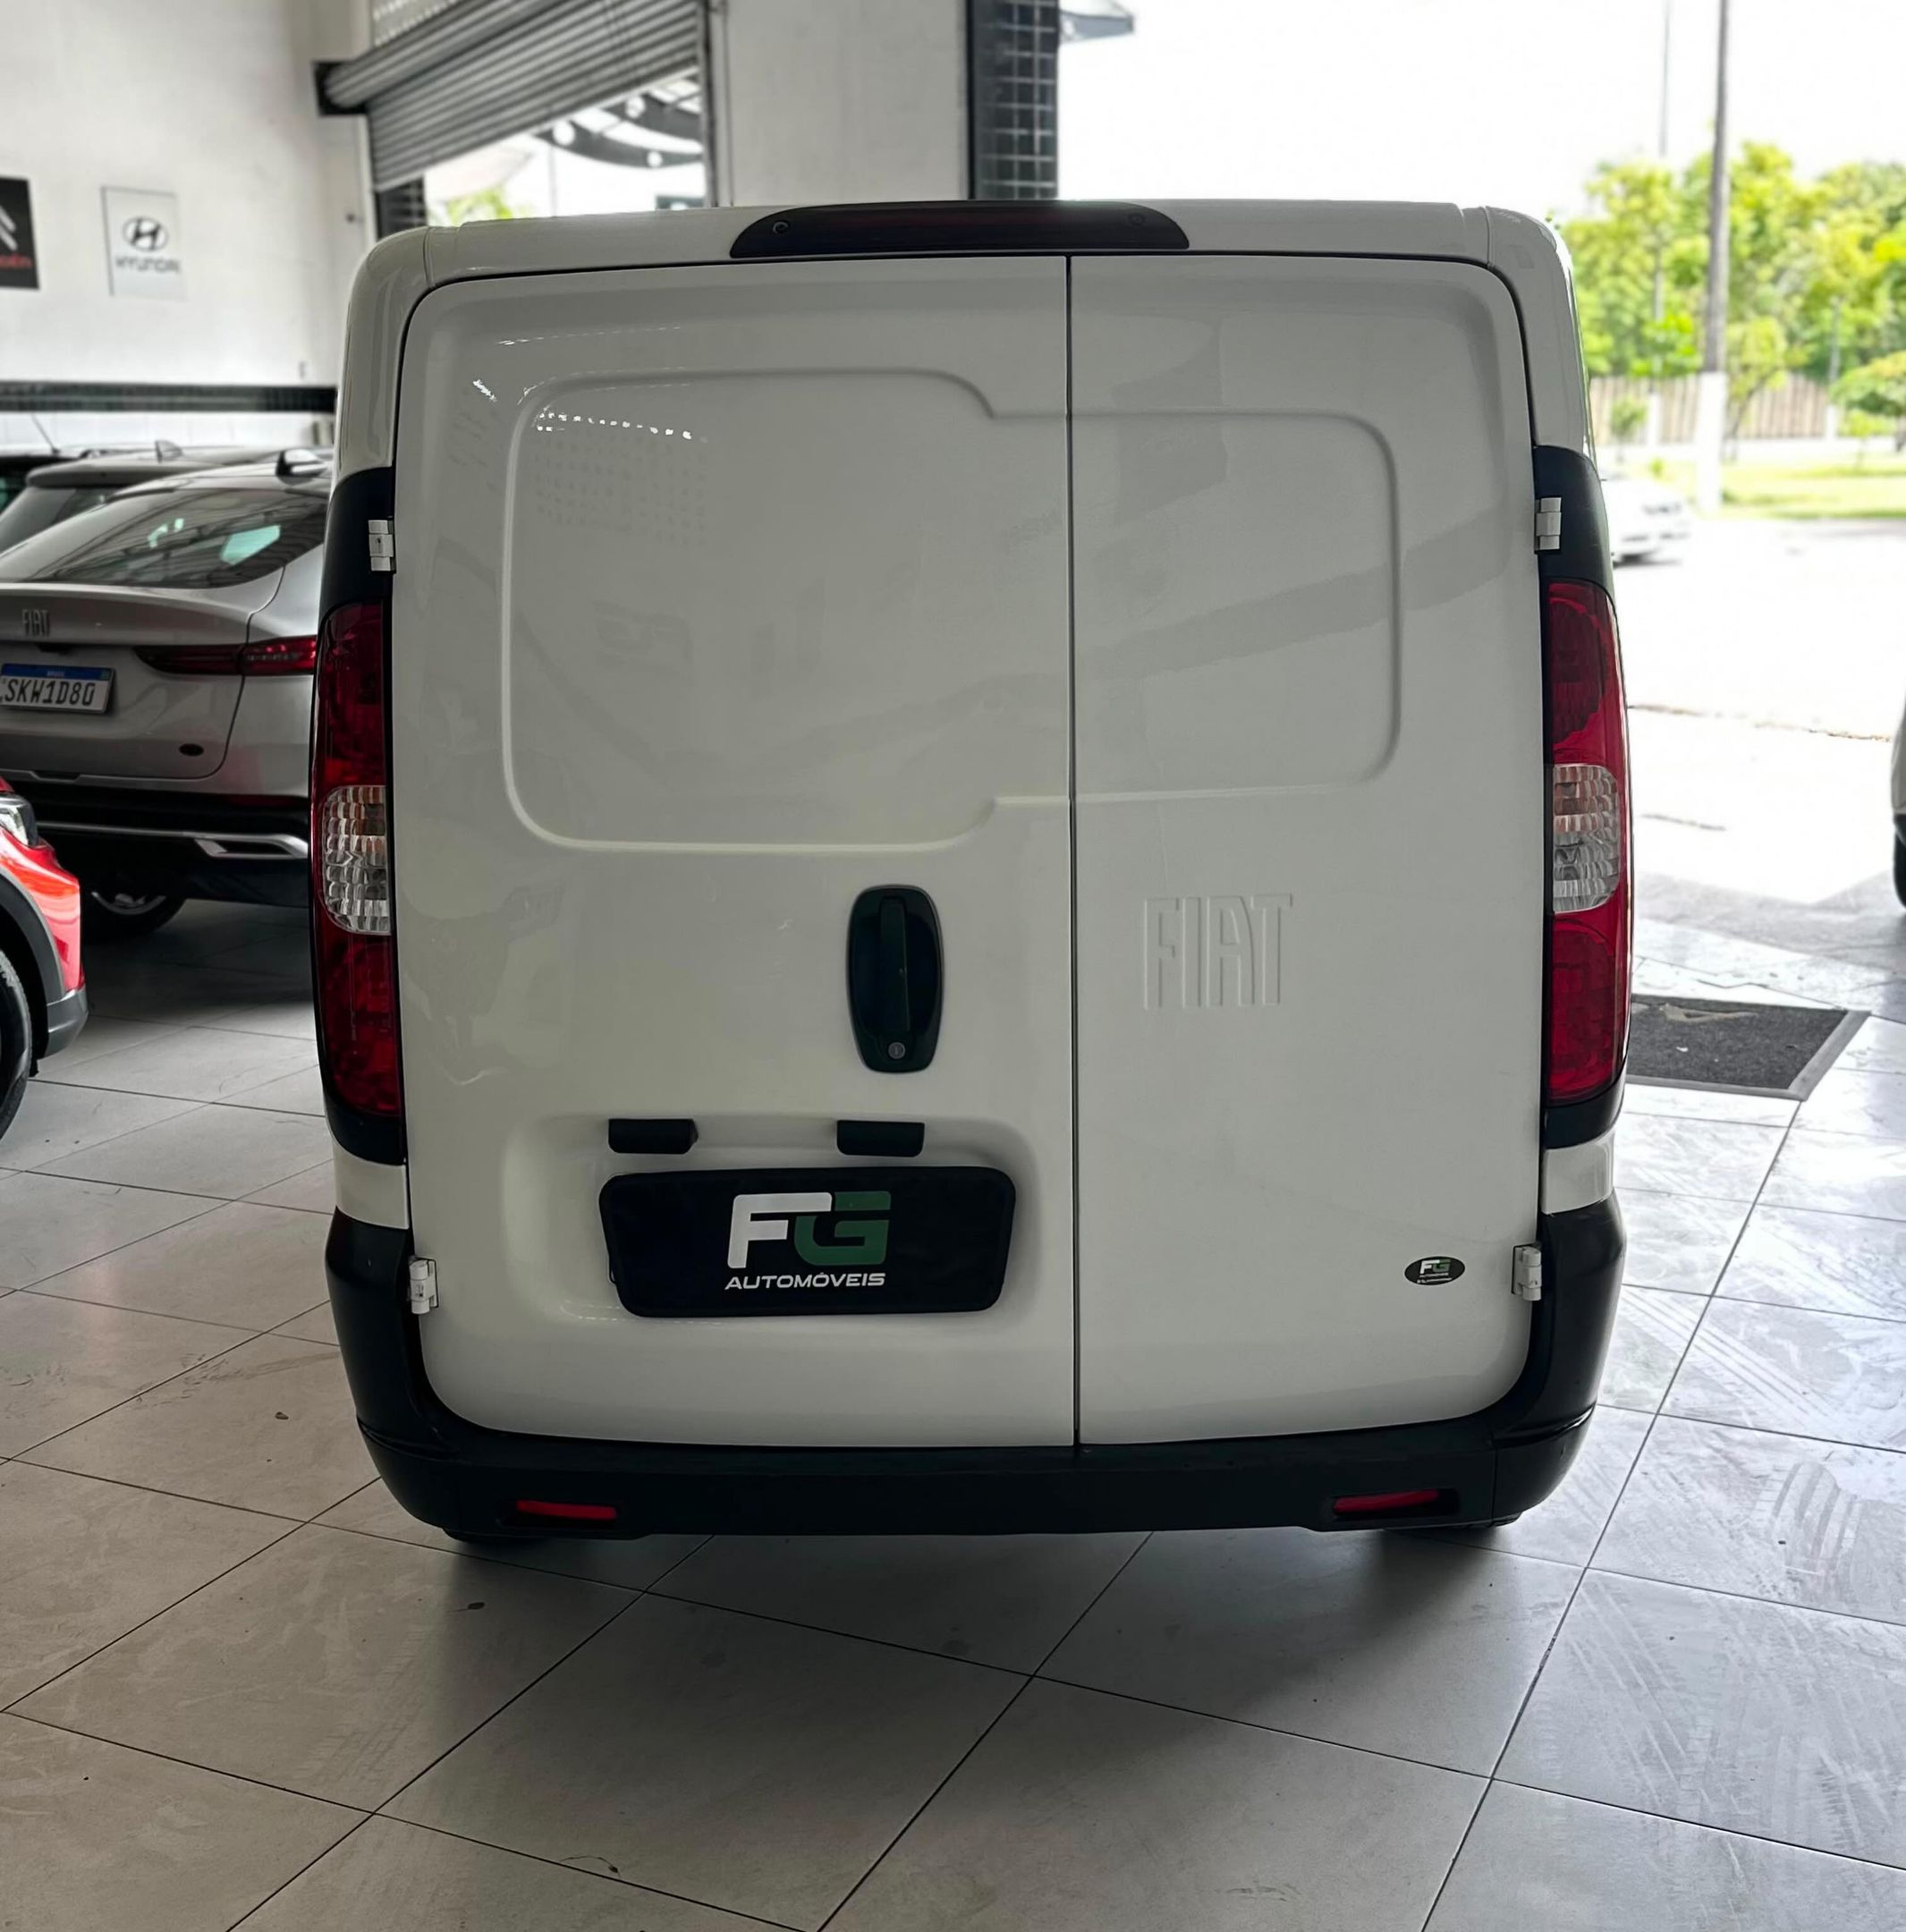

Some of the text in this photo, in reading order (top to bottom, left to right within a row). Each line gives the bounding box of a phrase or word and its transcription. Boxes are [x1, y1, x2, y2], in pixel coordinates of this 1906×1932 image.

[22, 609, 50, 637] FIAT
[4, 678, 96, 707] SKW1D80
[1143, 893, 1293, 1009] FIAT
[727, 1191, 892, 1269] FG
[724, 1272, 885, 1291] AUTOMÓVEIS
